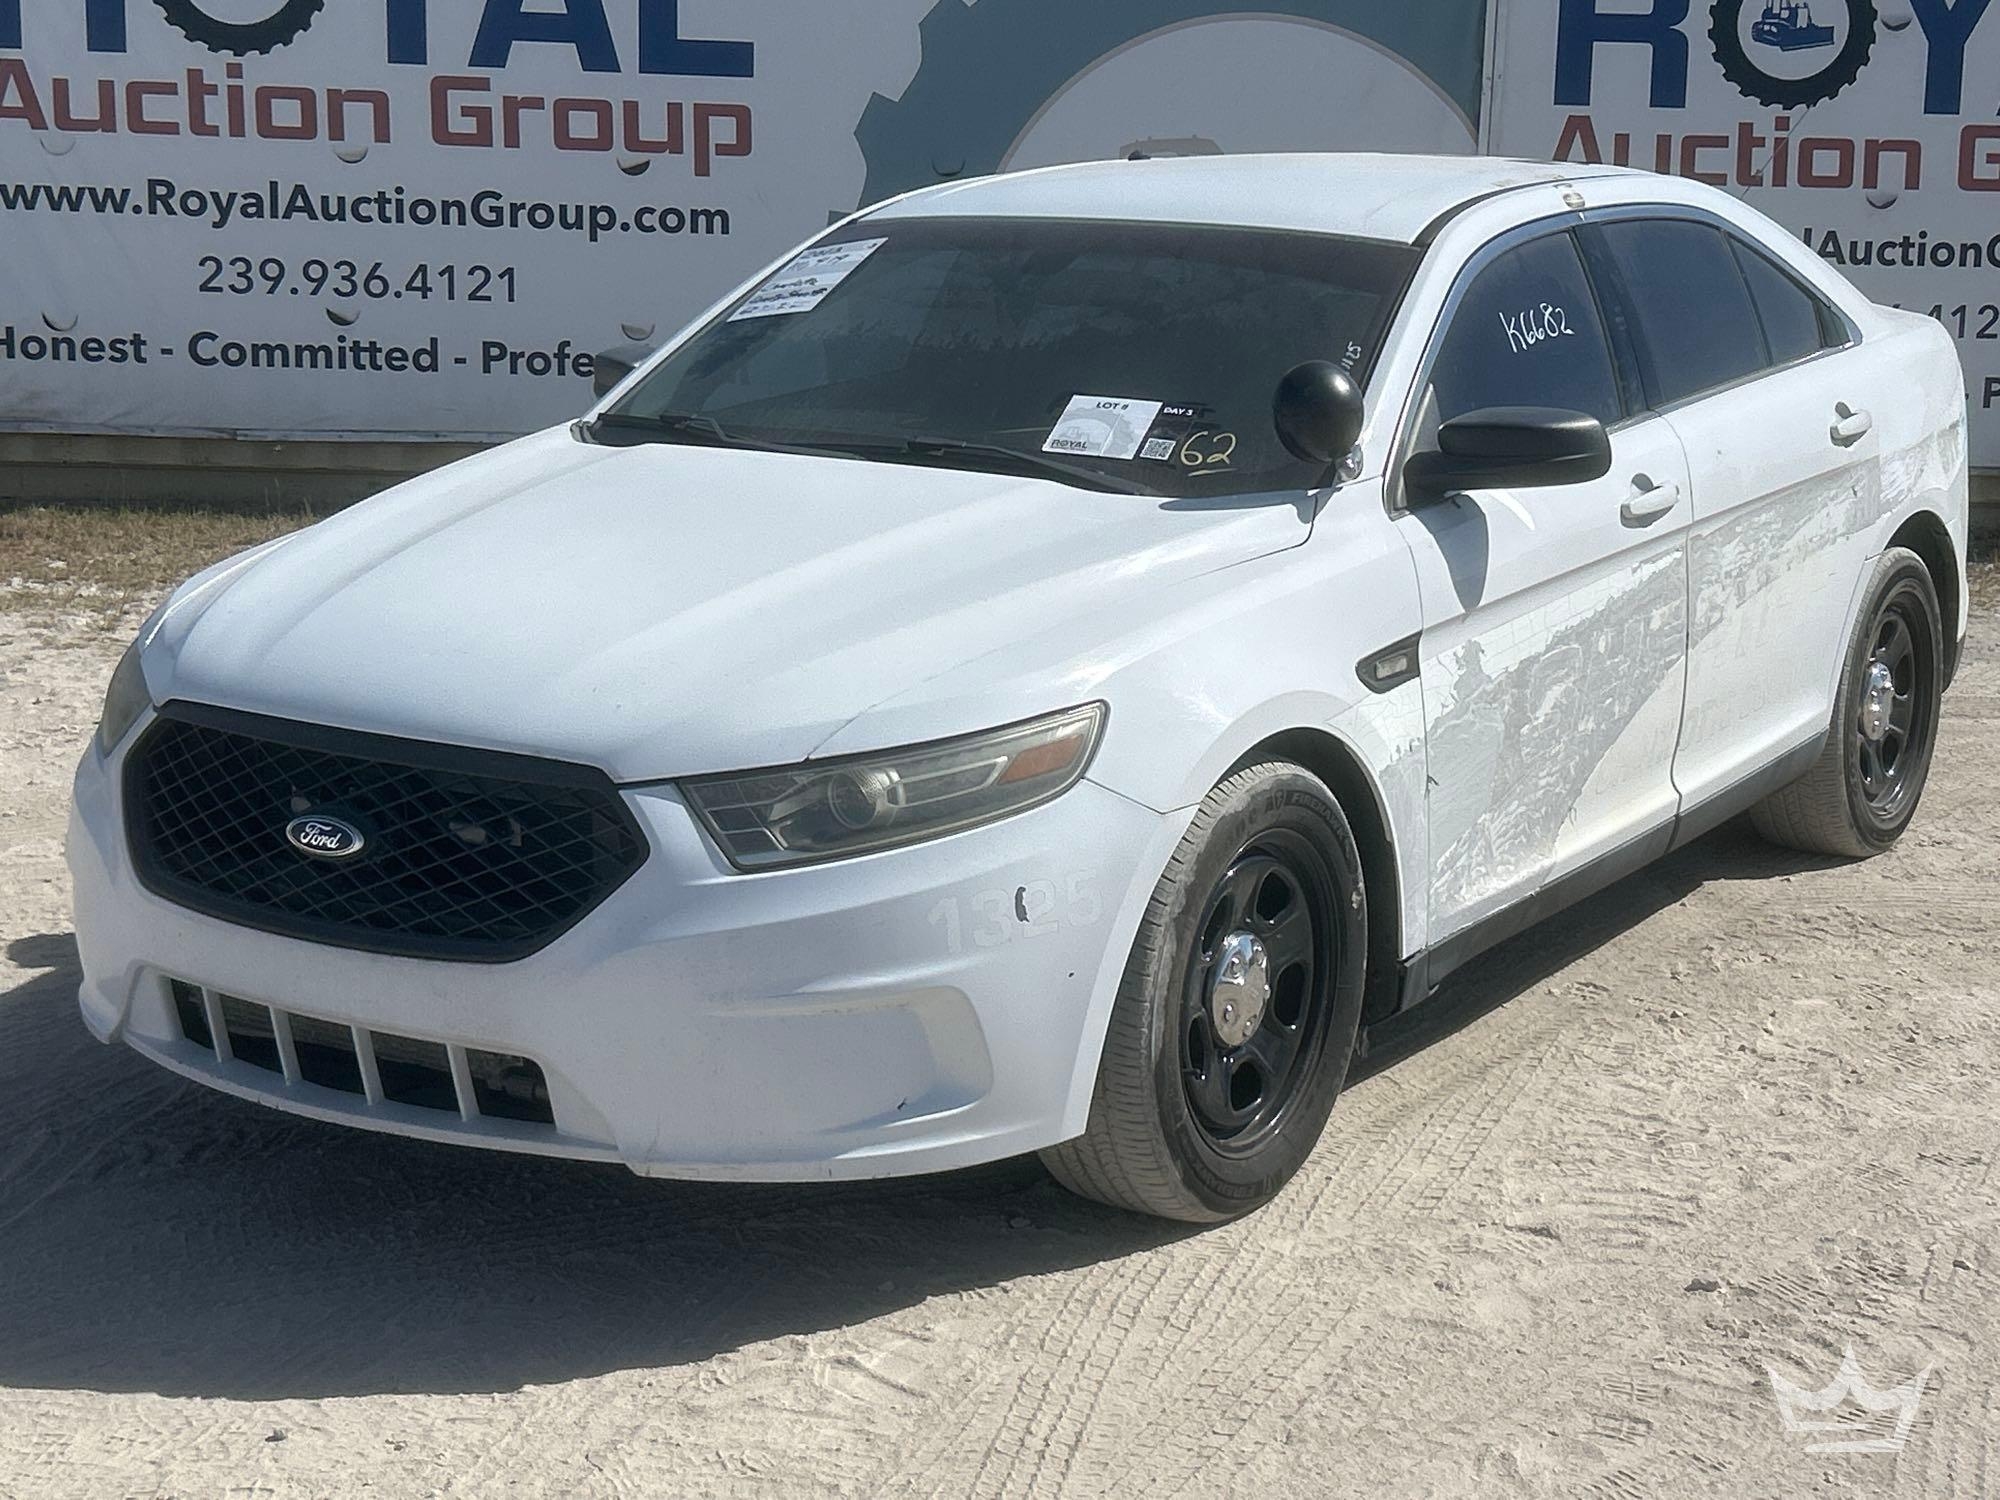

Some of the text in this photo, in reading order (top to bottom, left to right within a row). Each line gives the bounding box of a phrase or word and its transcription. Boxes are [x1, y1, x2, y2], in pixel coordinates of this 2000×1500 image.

[1553, 0, 2000, 116] ROY
[0, 58, 752, 177] Auction Group
[1552, 115, 1922, 191] Auction
[0, 178, 731, 242] www.RoyalAuctionGroup.com
[198, 256, 517, 303] 239.936.4121
[0, 326, 147, 364] Honest
[188, 331, 439, 374] Committed
[1499, 302, 1575, 353] K6682
[1096, 401, 1118, 410] LOT
[1163, 406, 1186, 415] DAY
[1180, 431, 1236, 466] 62
[300, 821, 342, 850] Ford
